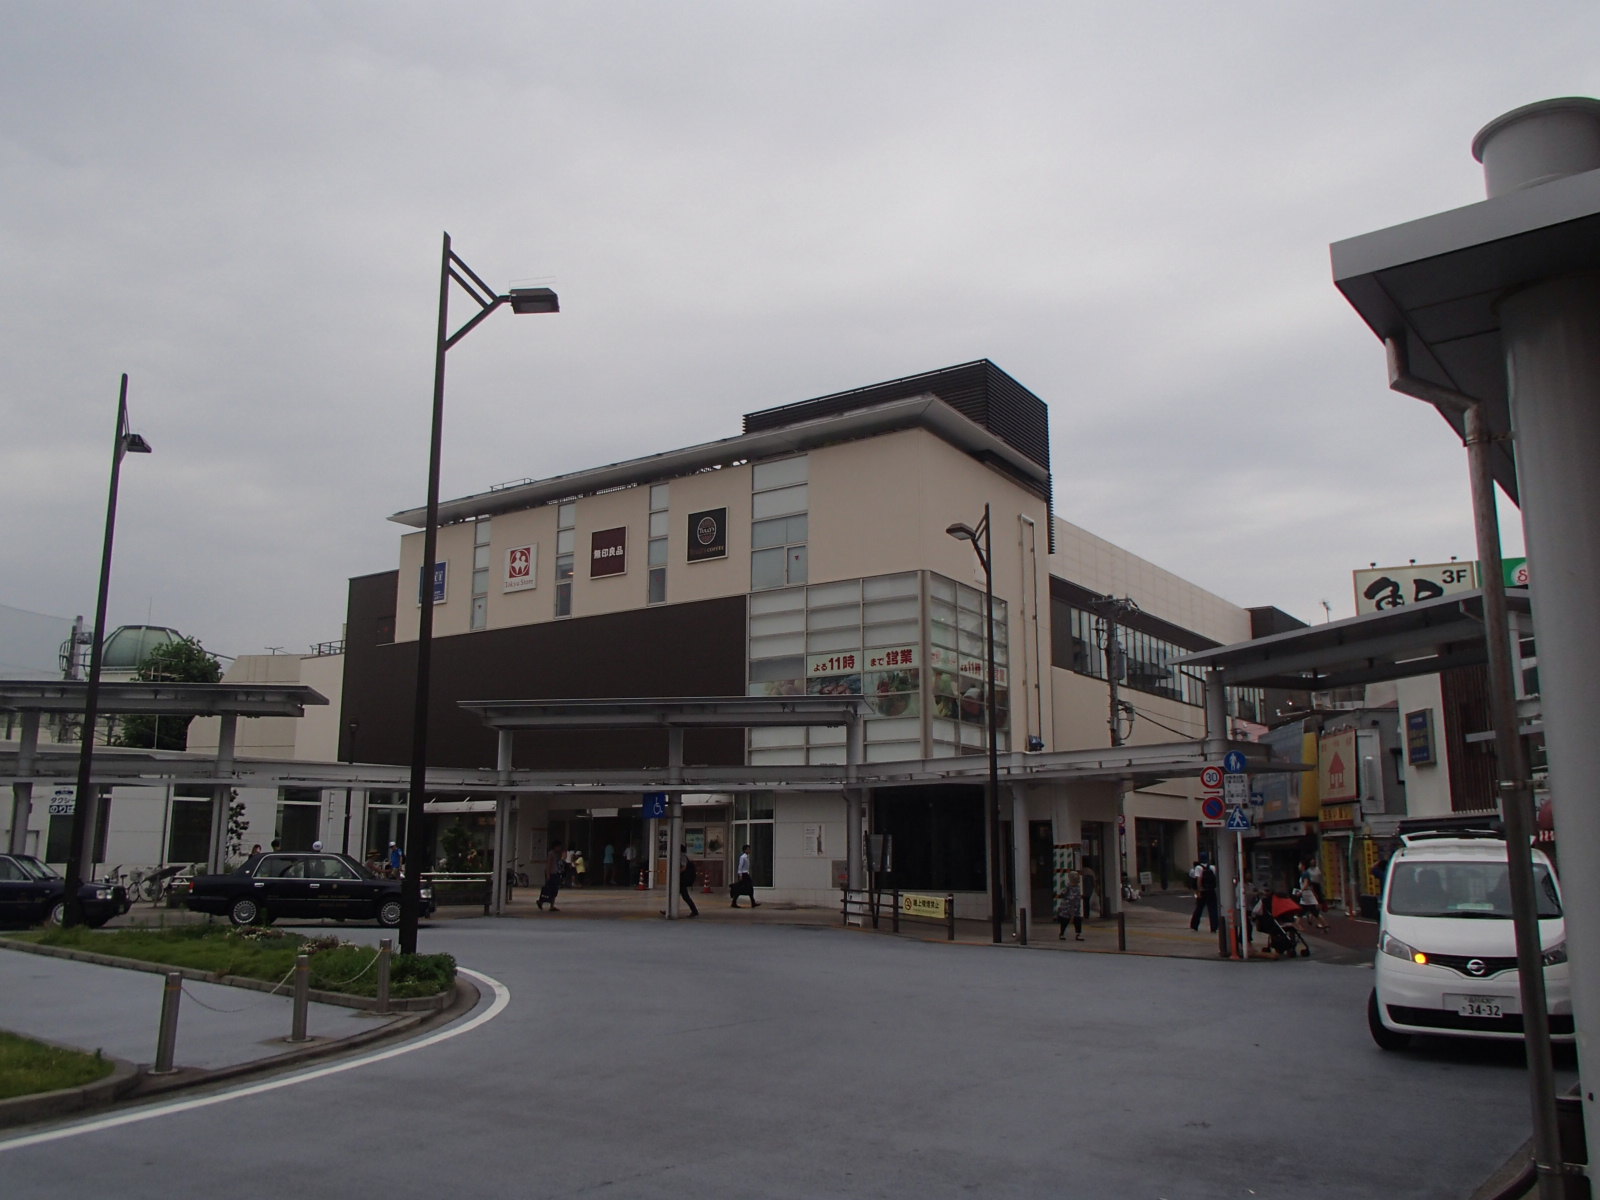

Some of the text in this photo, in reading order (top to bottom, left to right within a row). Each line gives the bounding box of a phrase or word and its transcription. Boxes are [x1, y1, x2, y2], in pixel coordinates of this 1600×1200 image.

[593, 545, 624, 559] 無印良品
[1442, 569, 1467, 584] 3F
[504, 580, 520, 589] Tokyu
[813, 655, 855, 672] よる11時
[870, 649, 913, 667] まで営業
[1206, 772, 1218, 783] 30
[1468, 1004, 1501, 1016] 34-32
